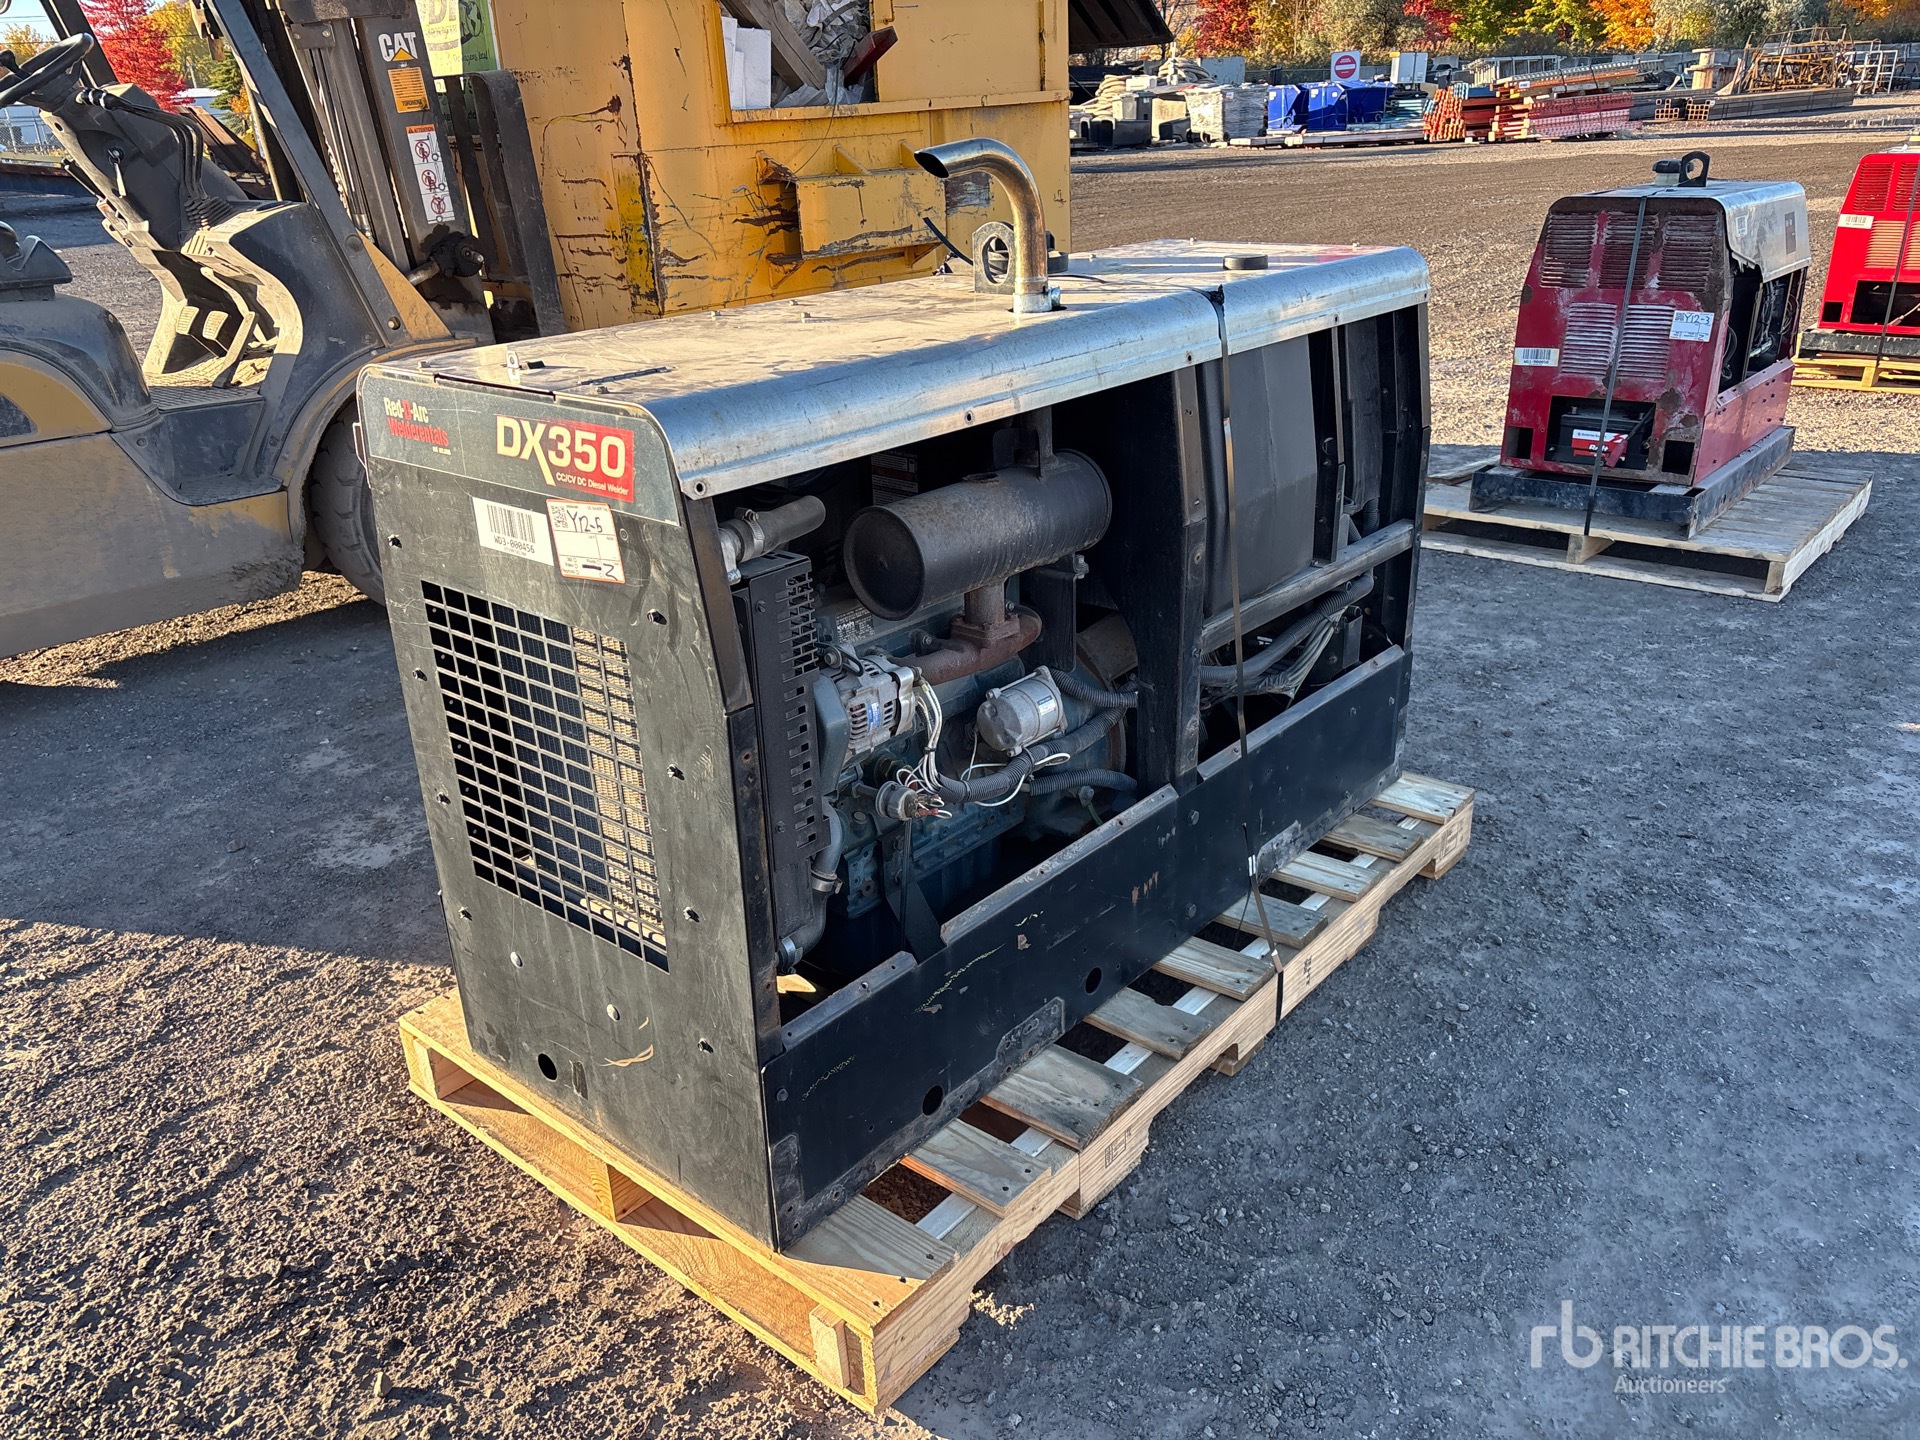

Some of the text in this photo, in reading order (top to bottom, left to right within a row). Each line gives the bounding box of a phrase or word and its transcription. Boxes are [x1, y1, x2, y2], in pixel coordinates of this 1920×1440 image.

[378, 31, 418, 62] CAT
[1684, 313, 1711, 325] Y12-3
[383, 396, 429, 424] Red-D-Arc
[387, 416, 449, 447] Welderentals
[496, 415, 626, 487] DX350
[556, 472, 629, 496] CC/CV DC Diesel Welder
[566, 509, 603, 533] Y12-5
